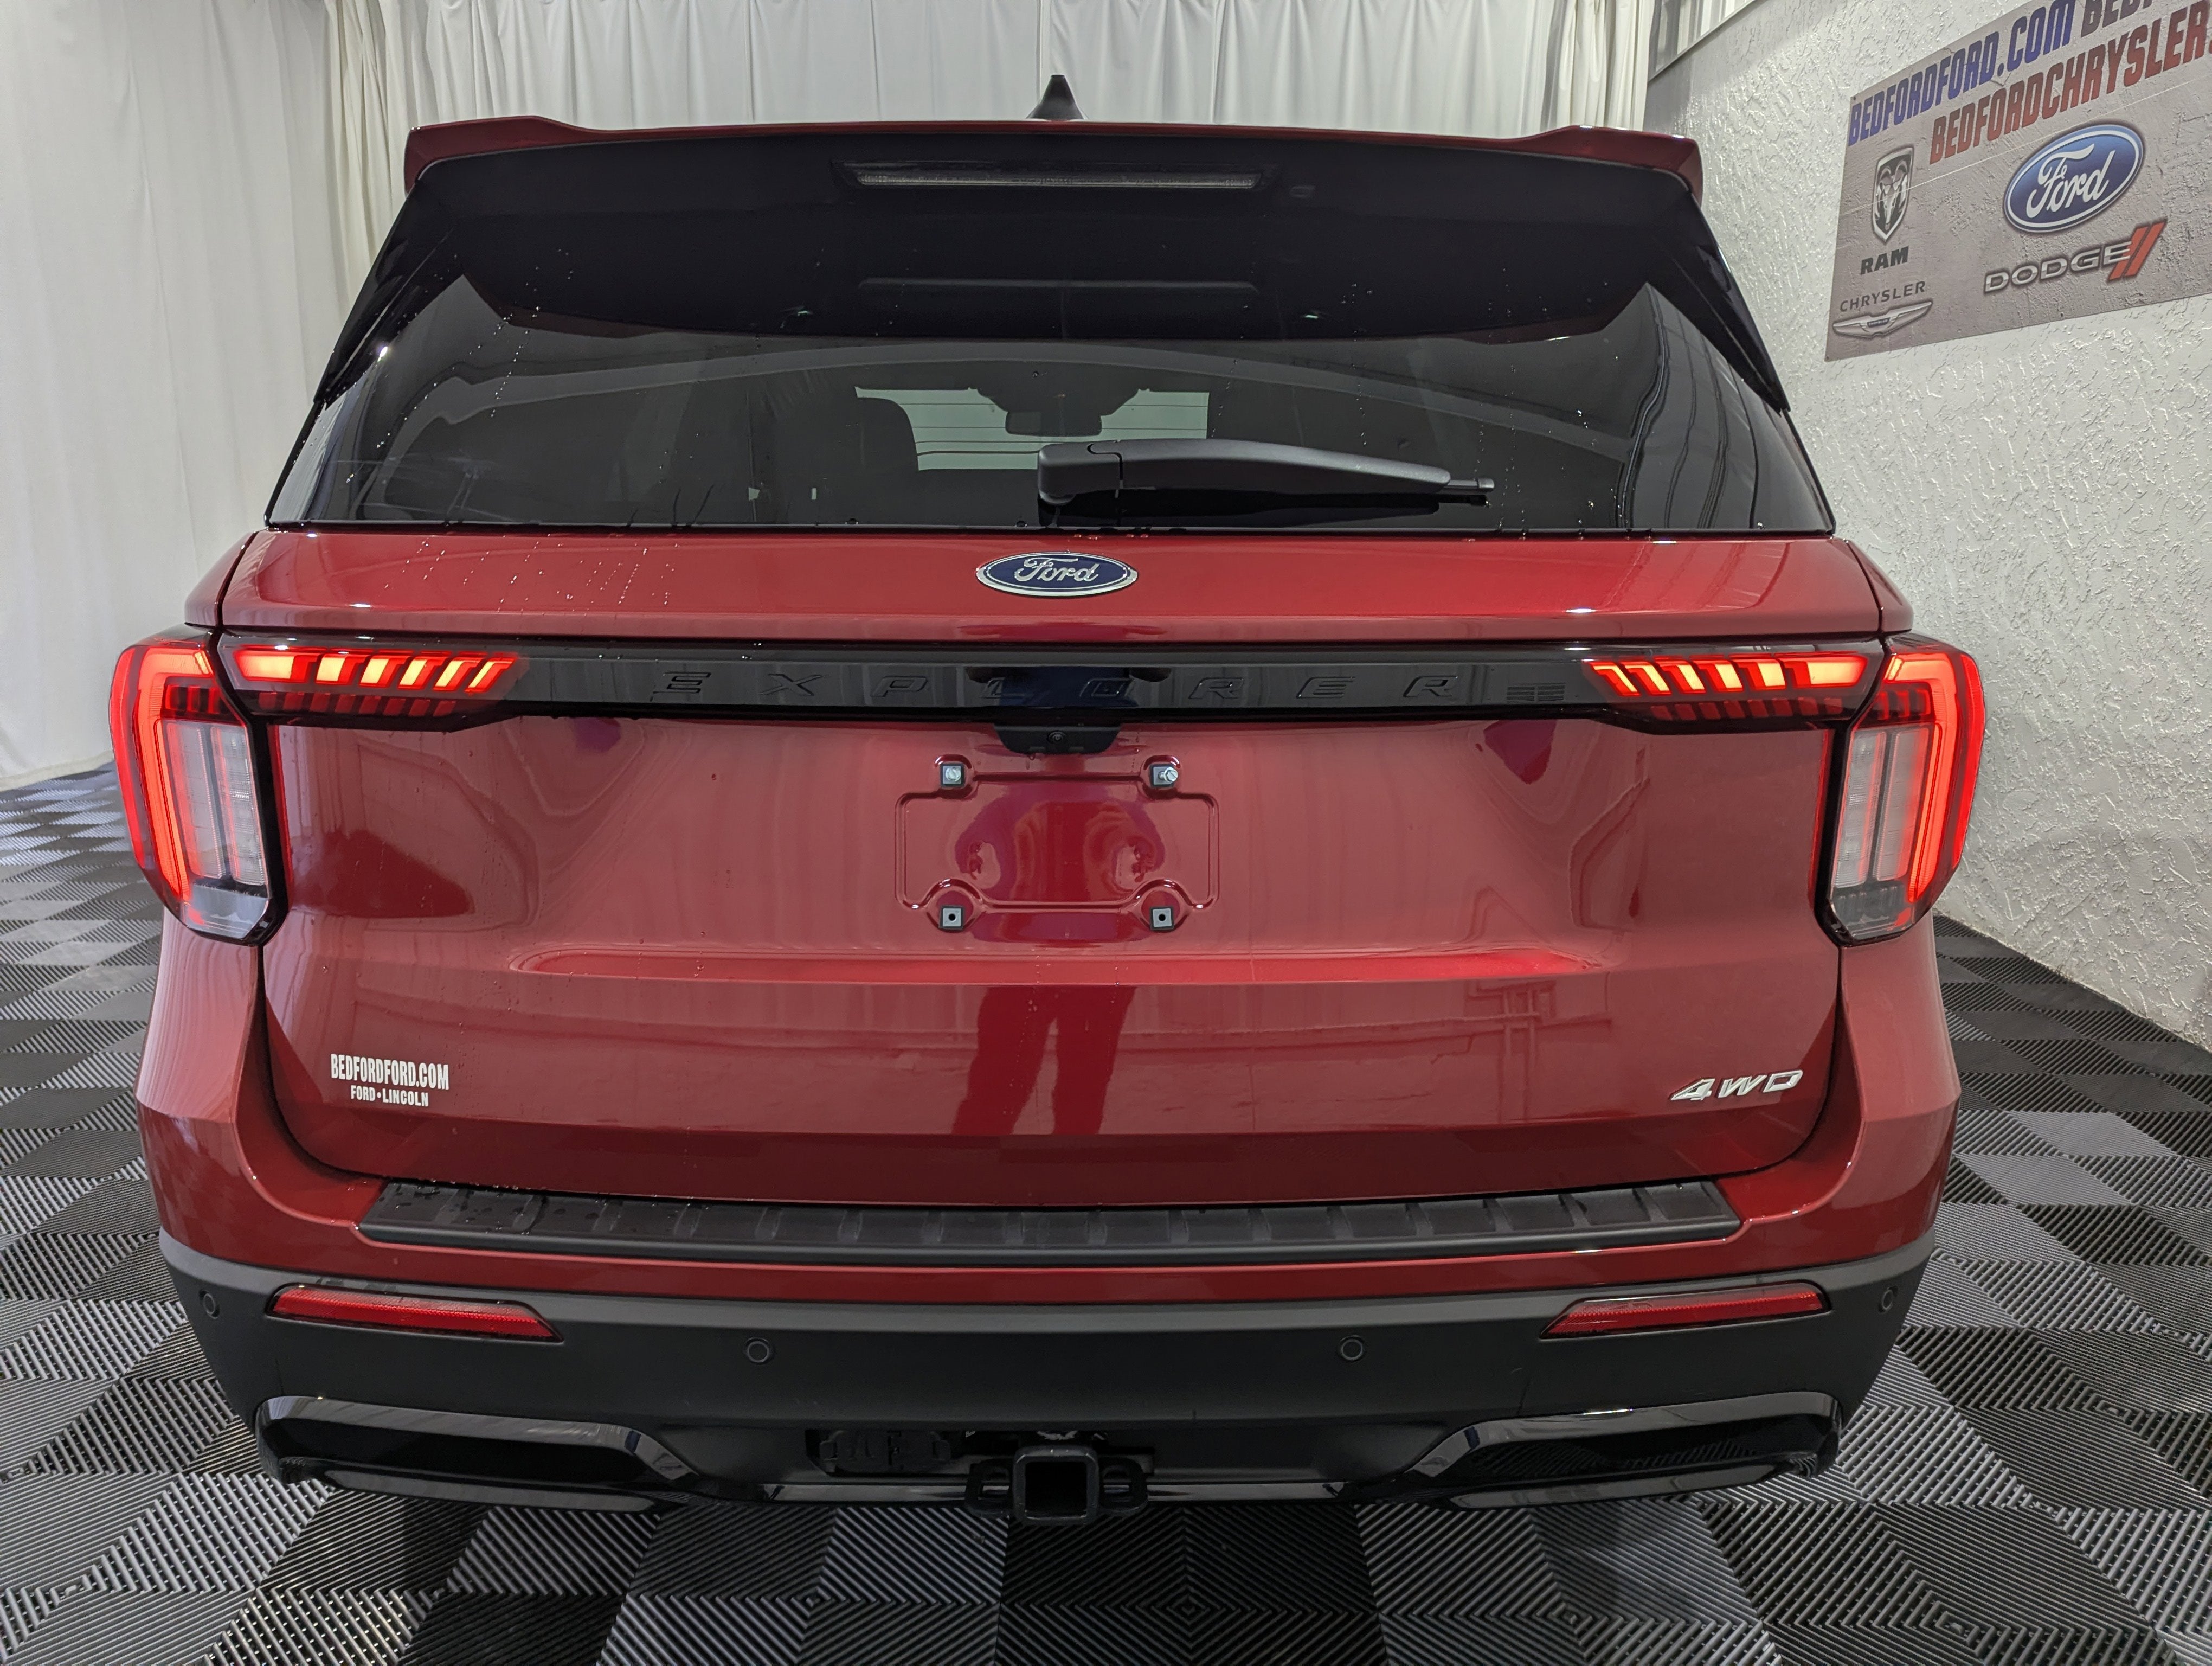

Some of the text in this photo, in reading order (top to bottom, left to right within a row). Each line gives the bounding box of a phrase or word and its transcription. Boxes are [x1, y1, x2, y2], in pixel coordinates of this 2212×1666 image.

[1848, 0, 2075, 146] BEDFORDFORD.COM
[1930, 0, 2212, 164] BEDFORDCHRYSLER
[2026, 143, 2115, 219] Ford
[1860, 246, 1909, 275] RAM
[1984, 241, 2132, 292] DODGE
[1840, 281, 1926, 312] CHRYSLER
[1014, 557, 1100, 582] Ford
[652, 670, 1458, 699] EXPLORER
[331, 1053, 449, 1090] BEDFORDFORD.COM
[1670, 1069, 1803, 1101] 4WD
